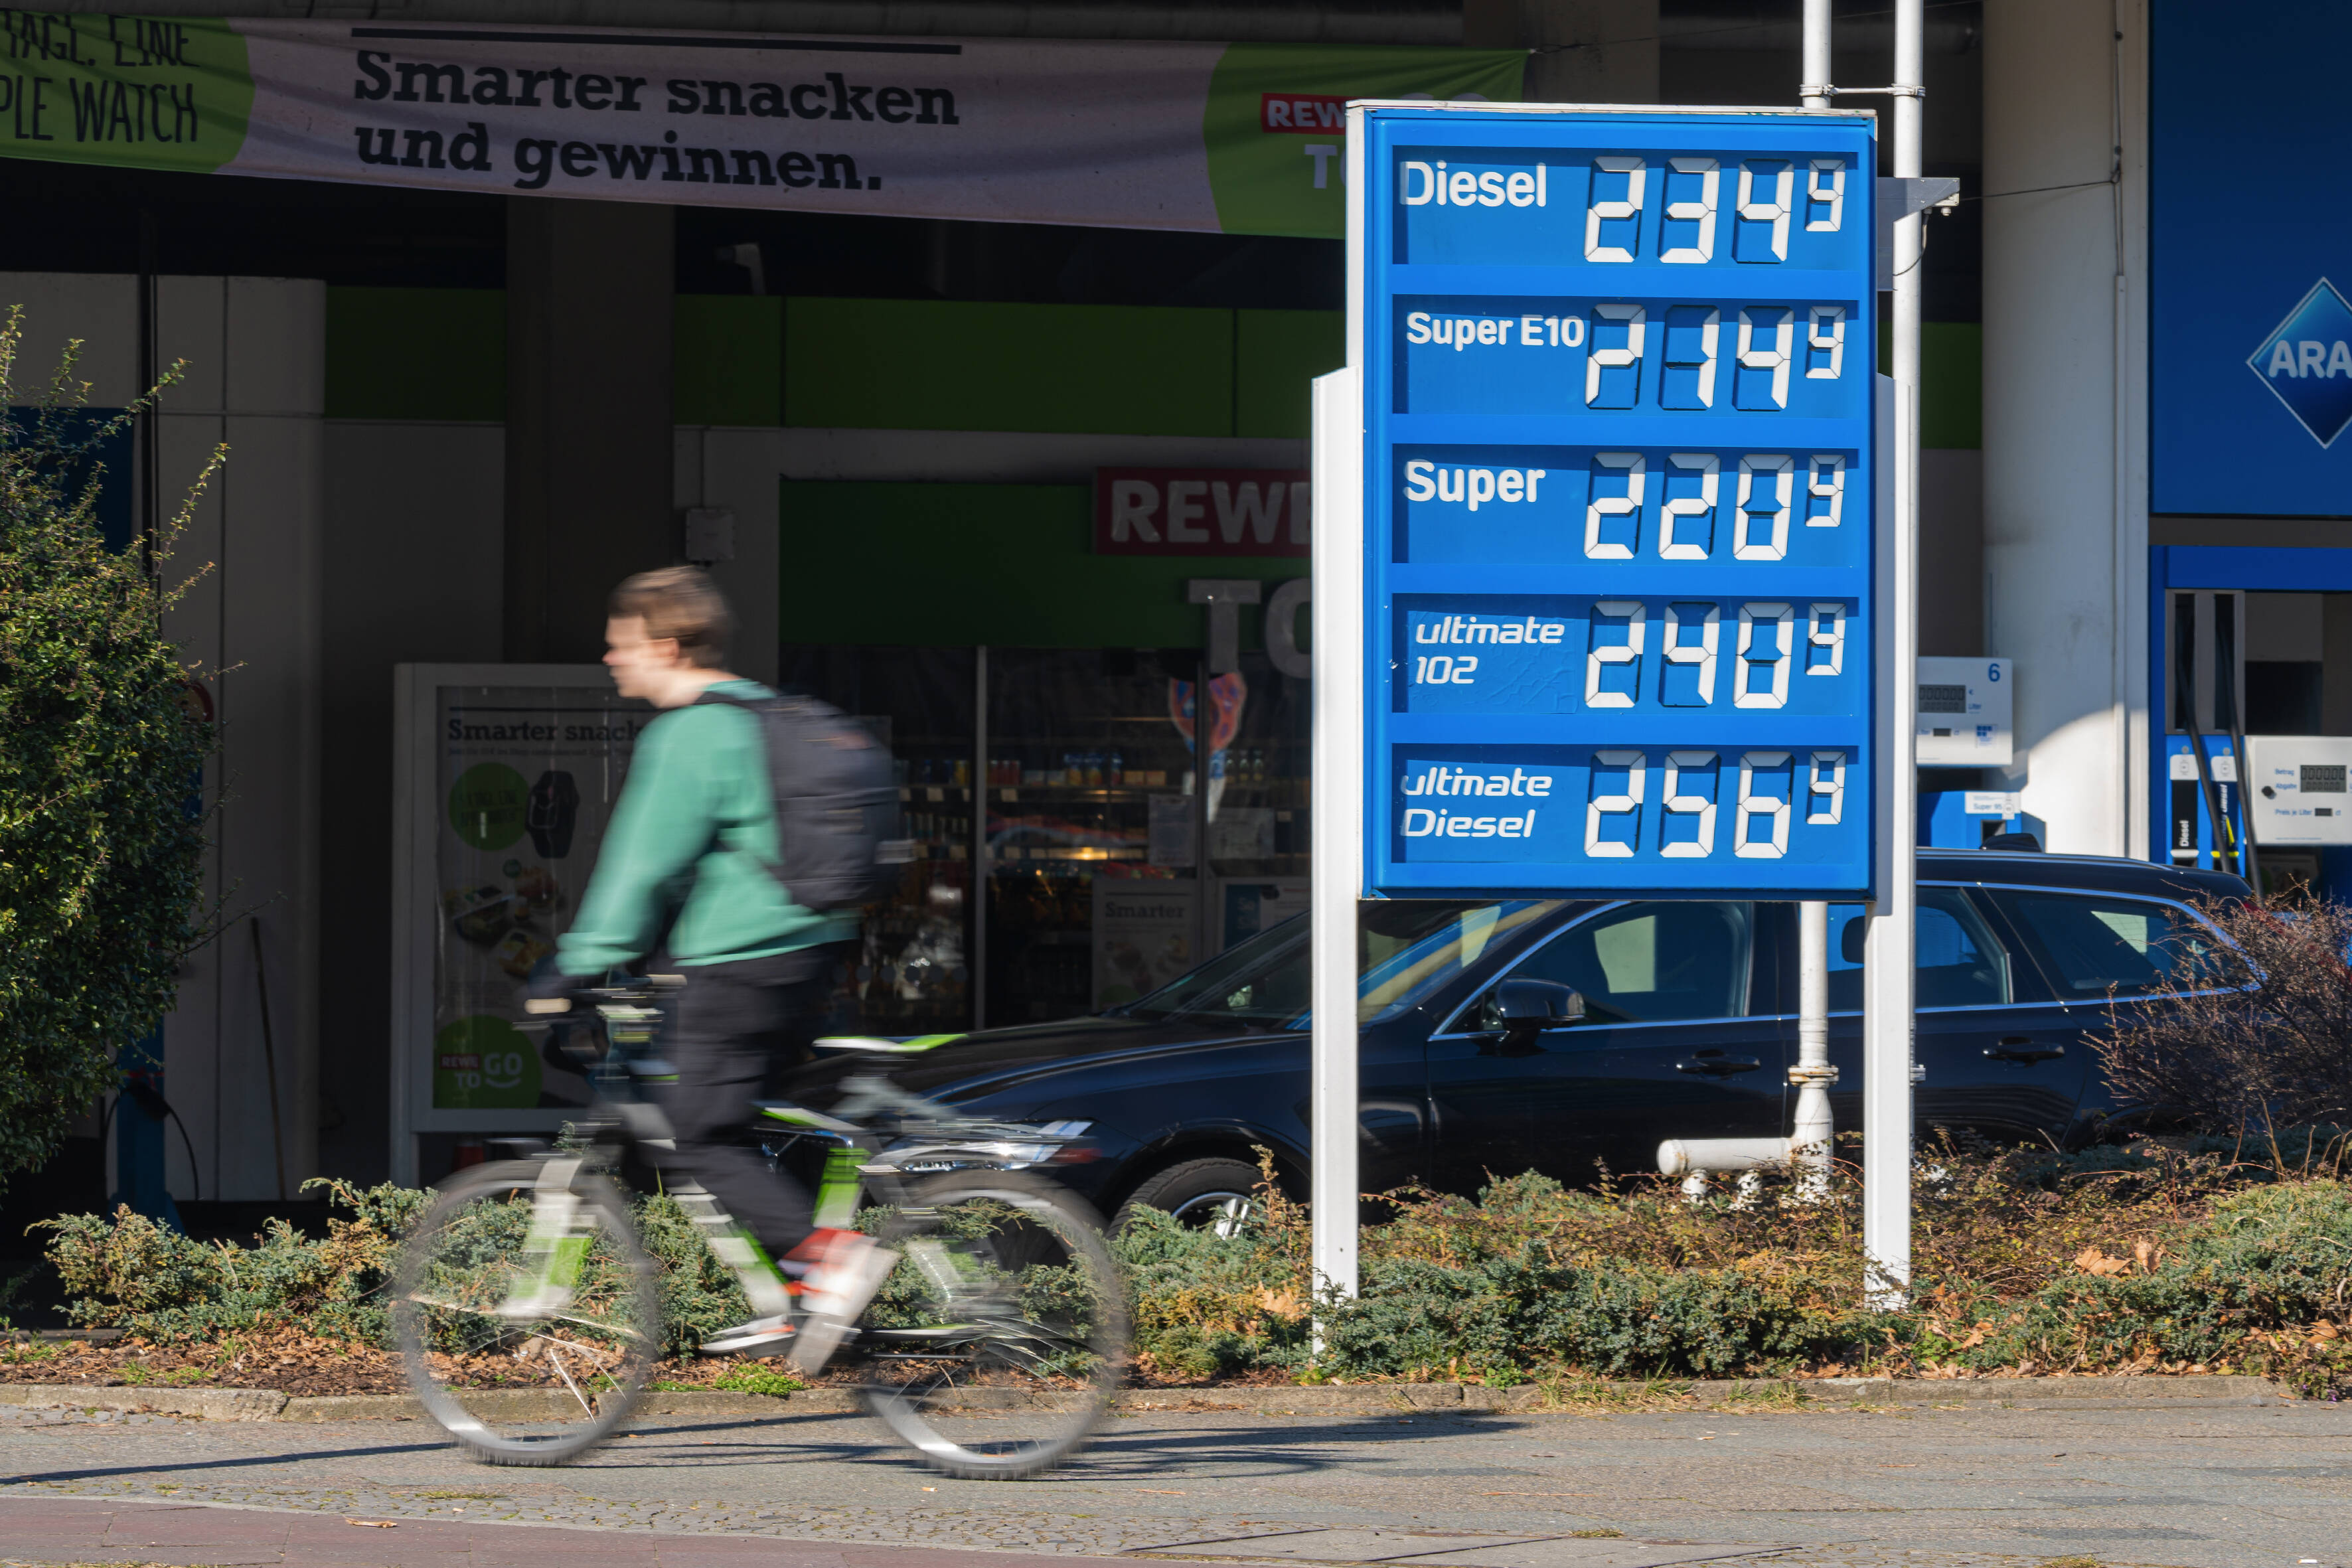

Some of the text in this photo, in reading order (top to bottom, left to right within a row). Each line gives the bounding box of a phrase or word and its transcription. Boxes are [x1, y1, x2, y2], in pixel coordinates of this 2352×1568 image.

[108, 15, 200, 67] EINE
[354, 50, 960, 125] Smarter snacken
[70, 78, 197, 143] WATCH
[1267, 100, 1346, 128] REW
[354, 121, 882, 190] und gewinnen.
[1304, 143, 1346, 189] T
[1399, 160, 1547, 207] Diesel
[1407, 312, 1514, 352] Super
[1521, 314, 1585, 347] E10
[1403, 459, 1546, 512] Super
[1415, 616, 1565, 644] ultimate
[1415, 656, 1478, 684] 102
[1988, 663, 2001, 682] 6
[448, 719, 556, 741] Smarter
[1400, 767, 1553, 797] ultimate
[1400, 809, 1536, 838] Diesel
[2179, 820, 2189, 847] Diesel
[1105, 902, 1185, 919] Smarter
[441, 1052, 523, 1076] REWE GO
[455, 1072, 481, 1089] TO
